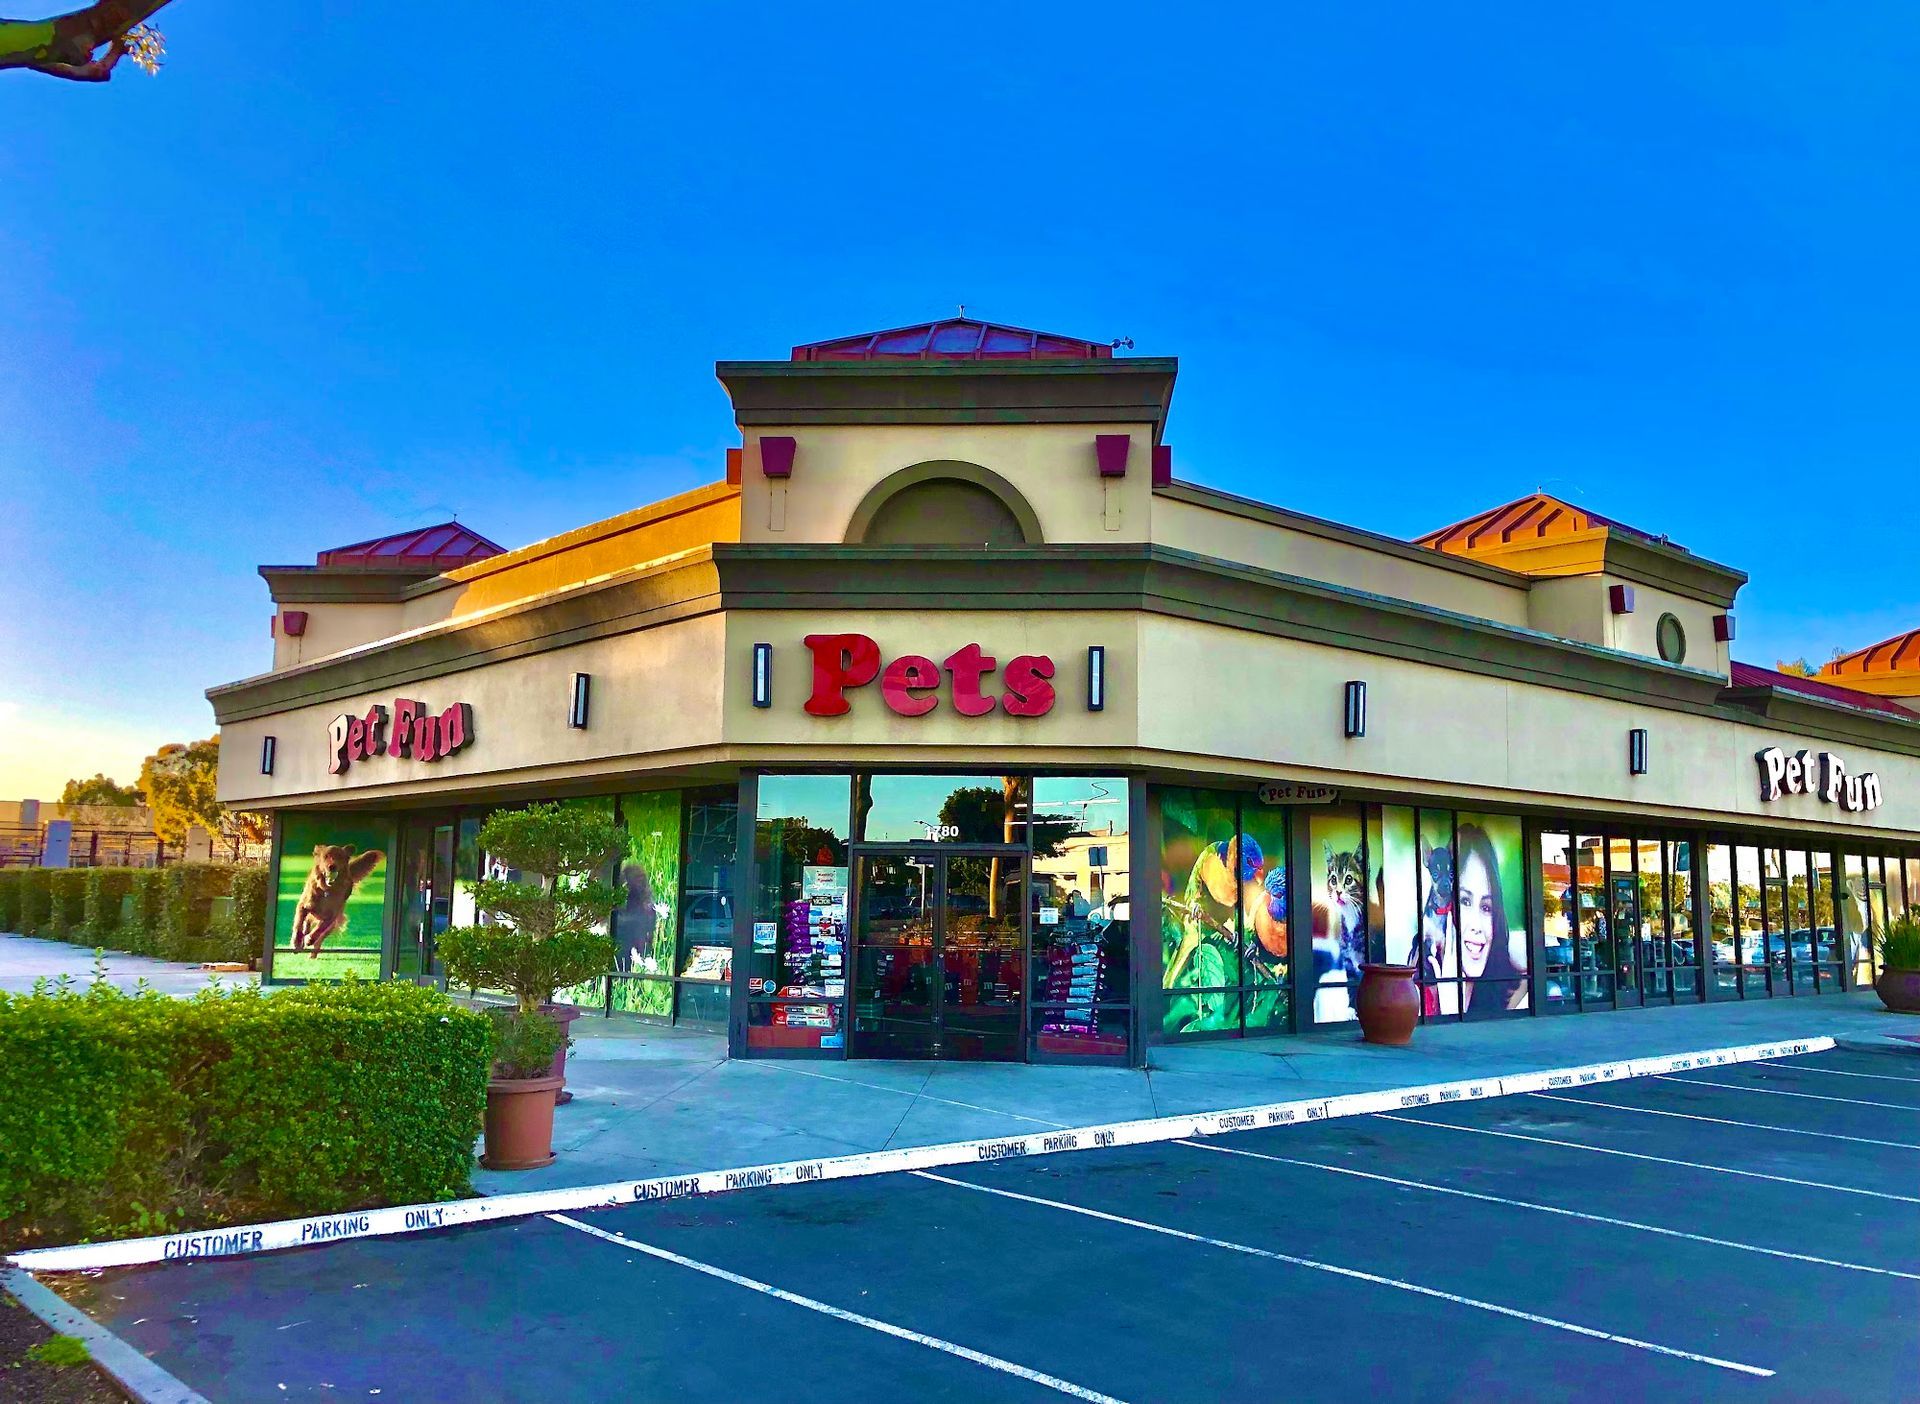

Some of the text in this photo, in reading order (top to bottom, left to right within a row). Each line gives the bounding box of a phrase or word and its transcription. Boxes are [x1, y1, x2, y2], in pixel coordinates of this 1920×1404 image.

[803, 633, 1055, 717] Pets
[328, 698, 474, 774] Pet Fun
[1268, 785, 1327, 801] Pet Fun
[1755, 747, 1883, 812] Pet Fun
[925, 825, 960, 838] 1780
[1400, 1093, 1430, 1106] CUSTOMER
[1440, 1089, 1461, 1101] PARKING
[1219, 1106, 1323, 1129] CUSTOMER PARKING ONLY
[978, 1131, 1115, 1160] CUSTOMER PARKING ONLY
[634, 1162, 823, 1201] CUSTOMER PARKING ONLY
[163, 1207, 444, 1260] CUSTOMER PARKING ONLY
